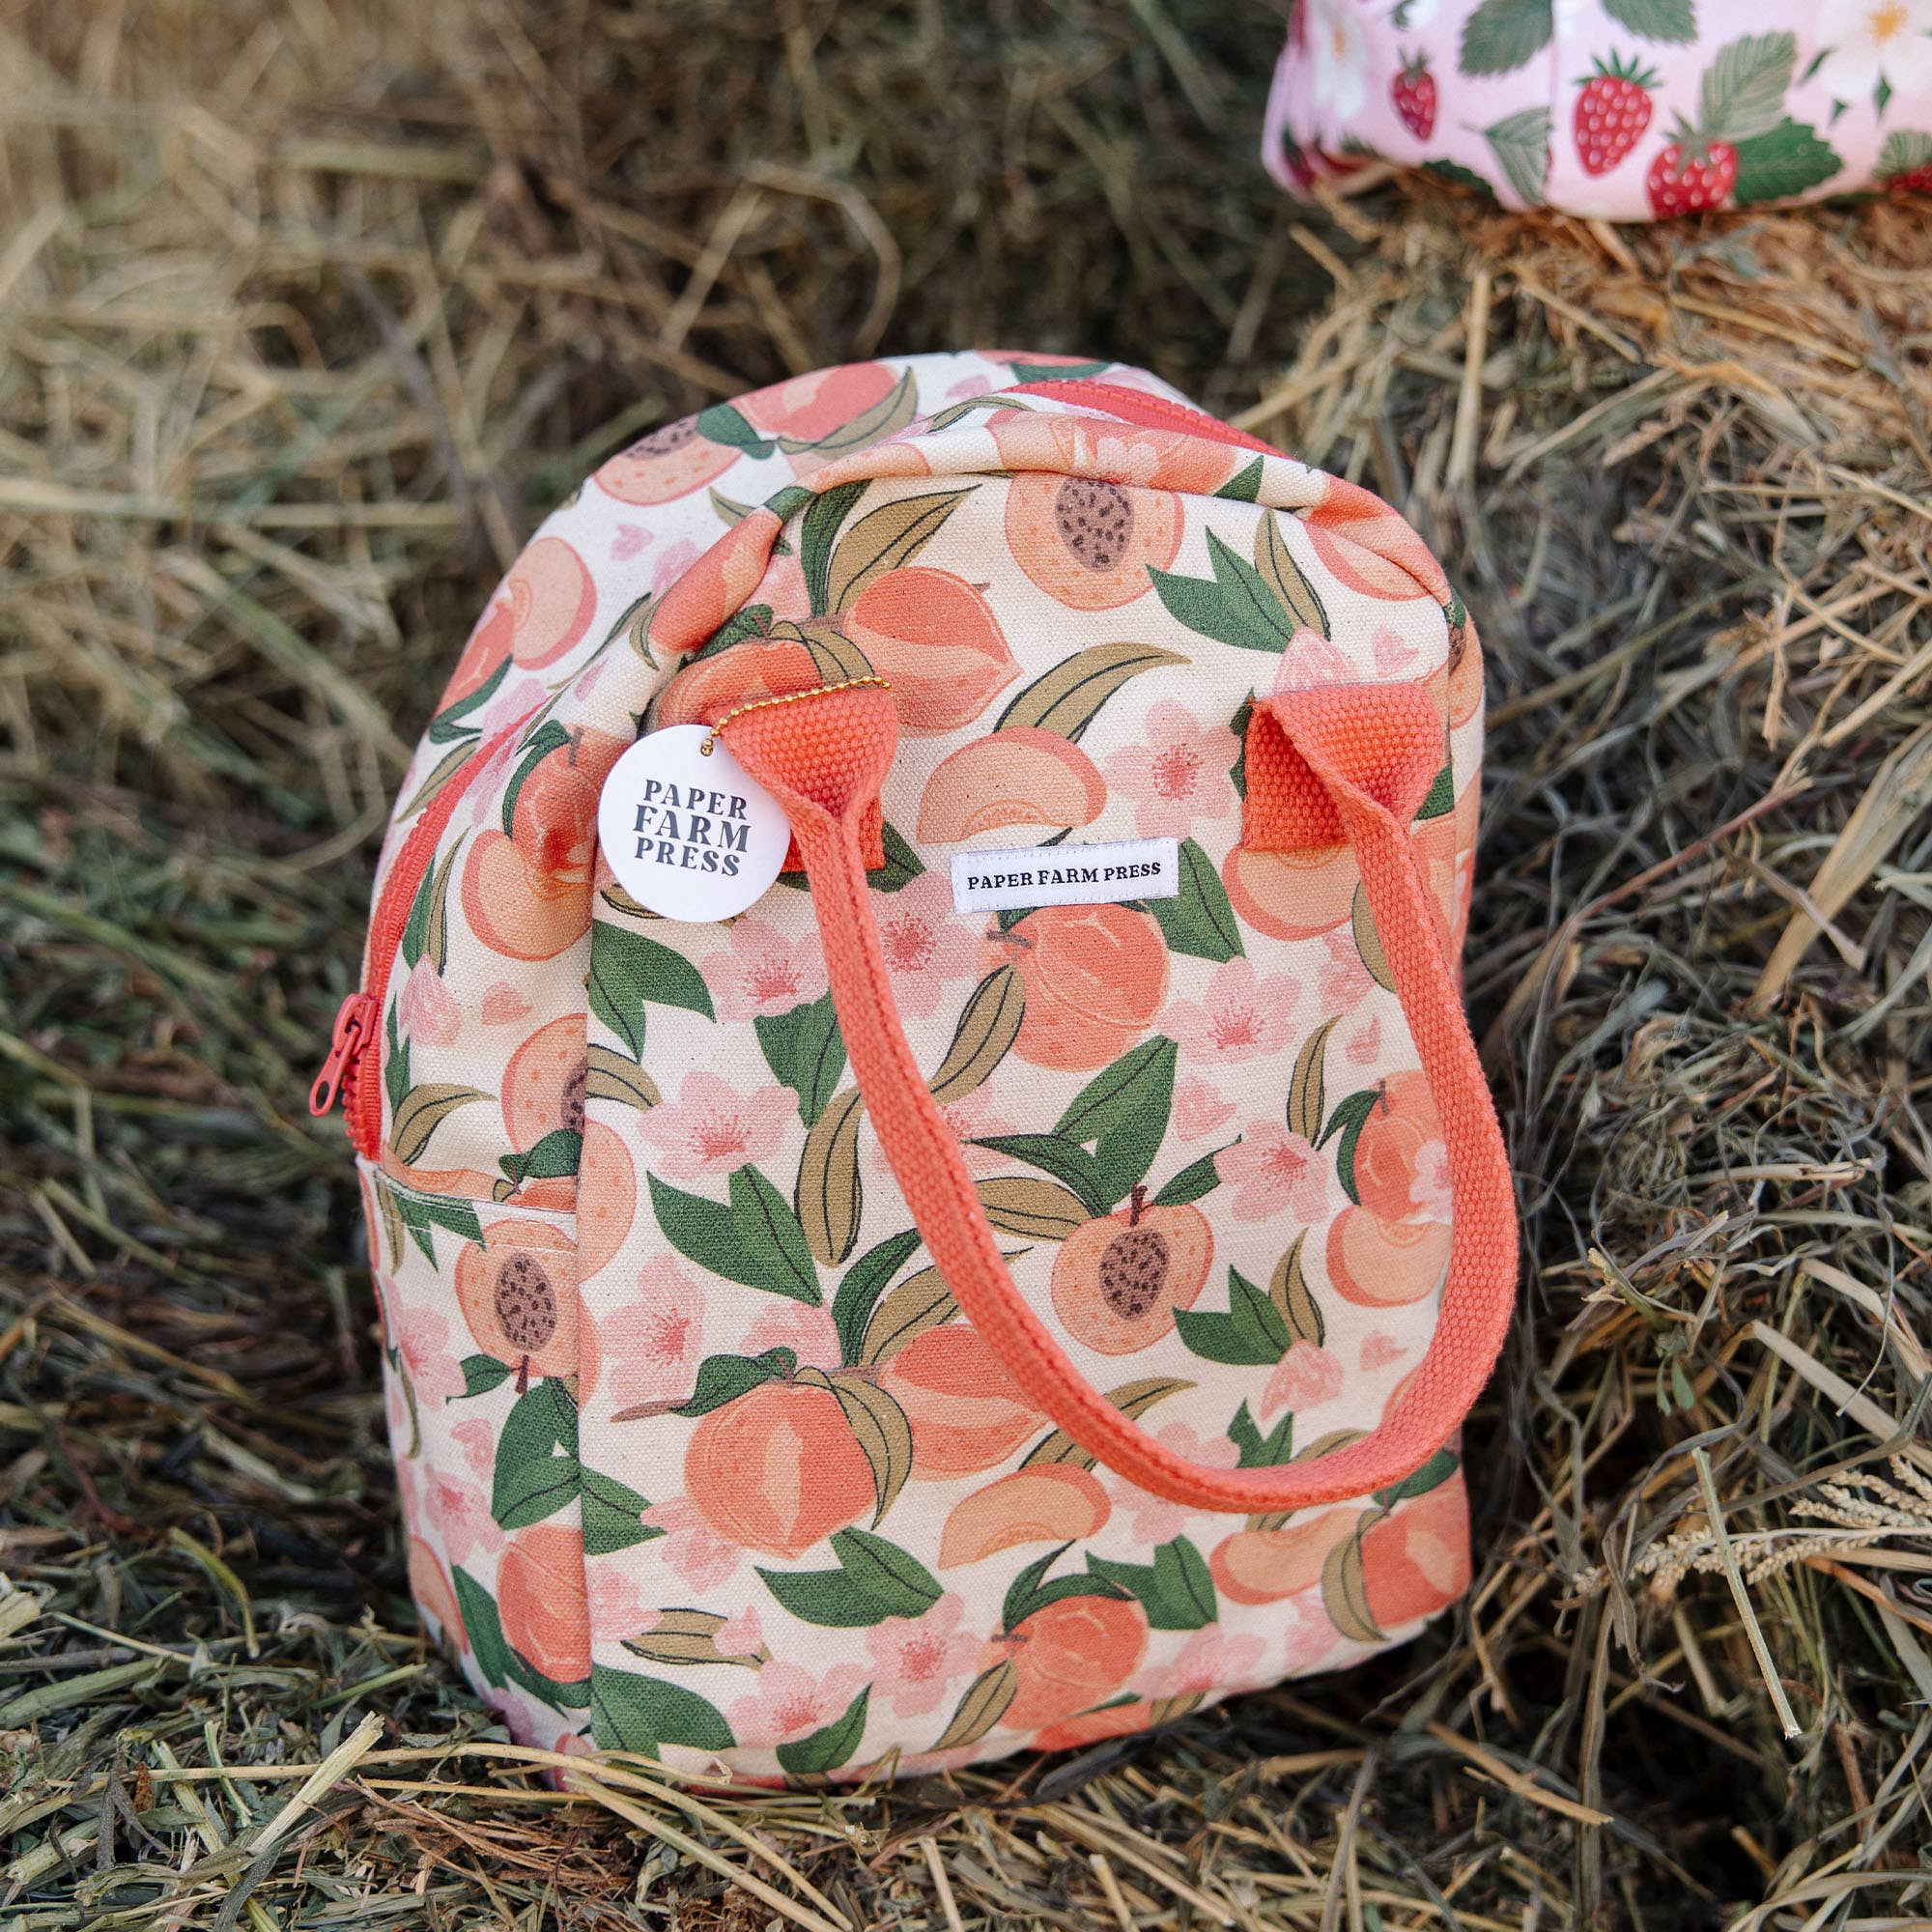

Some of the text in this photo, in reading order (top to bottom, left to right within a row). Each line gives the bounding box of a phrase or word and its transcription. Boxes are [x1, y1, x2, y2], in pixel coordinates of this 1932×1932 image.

[643, 780, 747, 820] PAPER
[633, 804, 751, 852] FARM
[635, 837, 740, 876] PRESS
[968, 862, 1161, 890] PAPER FARM PRESS
